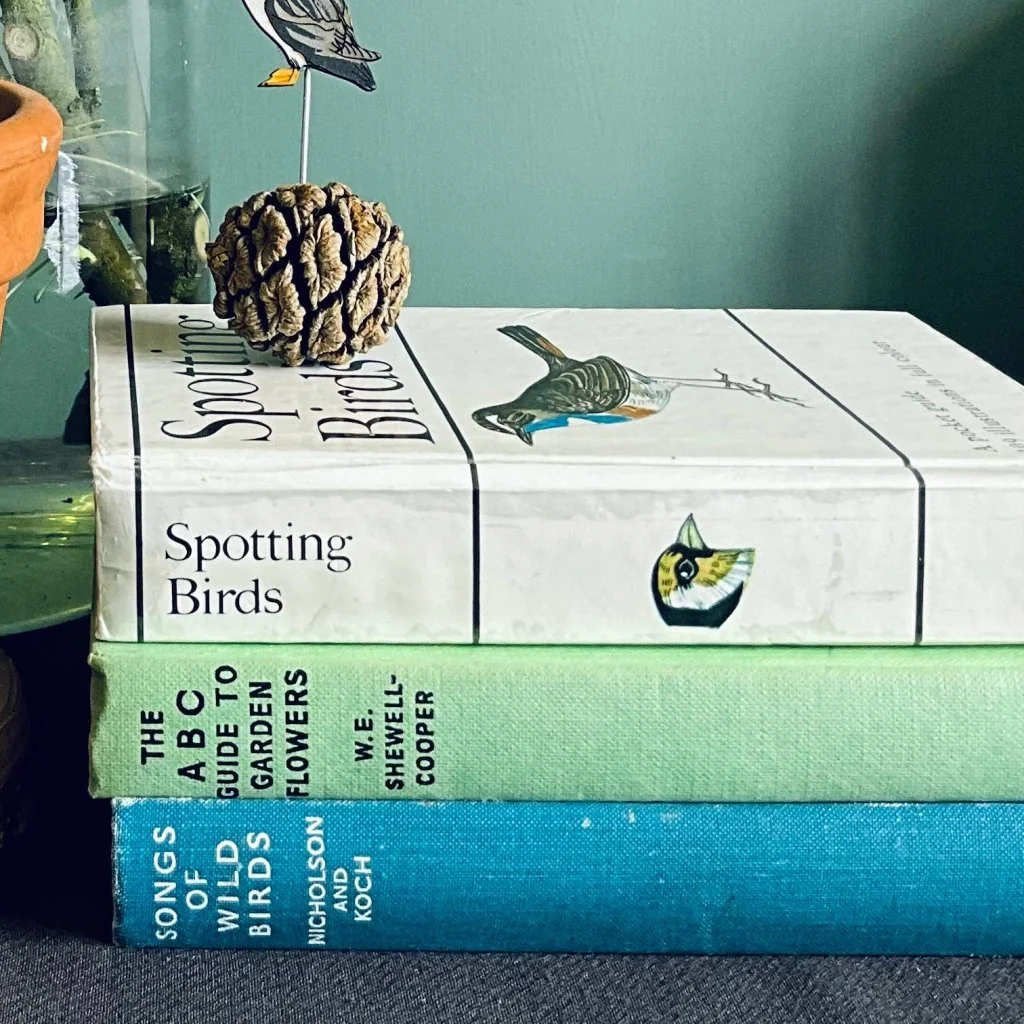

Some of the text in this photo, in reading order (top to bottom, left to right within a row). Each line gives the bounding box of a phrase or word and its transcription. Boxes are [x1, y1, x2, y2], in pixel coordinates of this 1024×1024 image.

[299, 359, 435, 444] Birds
[164, 522, 353, 573] Spotting
[167, 577, 284, 615] Birds
[140, 710, 165, 766] THE
[214, 665, 240, 800] GUIDE TO
[249, 681, 274, 791] GARDEN
[284, 668, 310, 798] FLOWERS
[384, 674, 405, 791] SHEWELL-
[415, 690, 436, 787] COOPER
[153, 825, 178, 941] SONGS
[184, 869, 209, 911] OF
[216, 839, 240, 933] WILD
[247, 831, 272, 937] BIRDS
[305, 815, 326, 946] NICHOLSON
[332, 867, 349, 912] AND
[353, 855, 372, 922] KOCH
